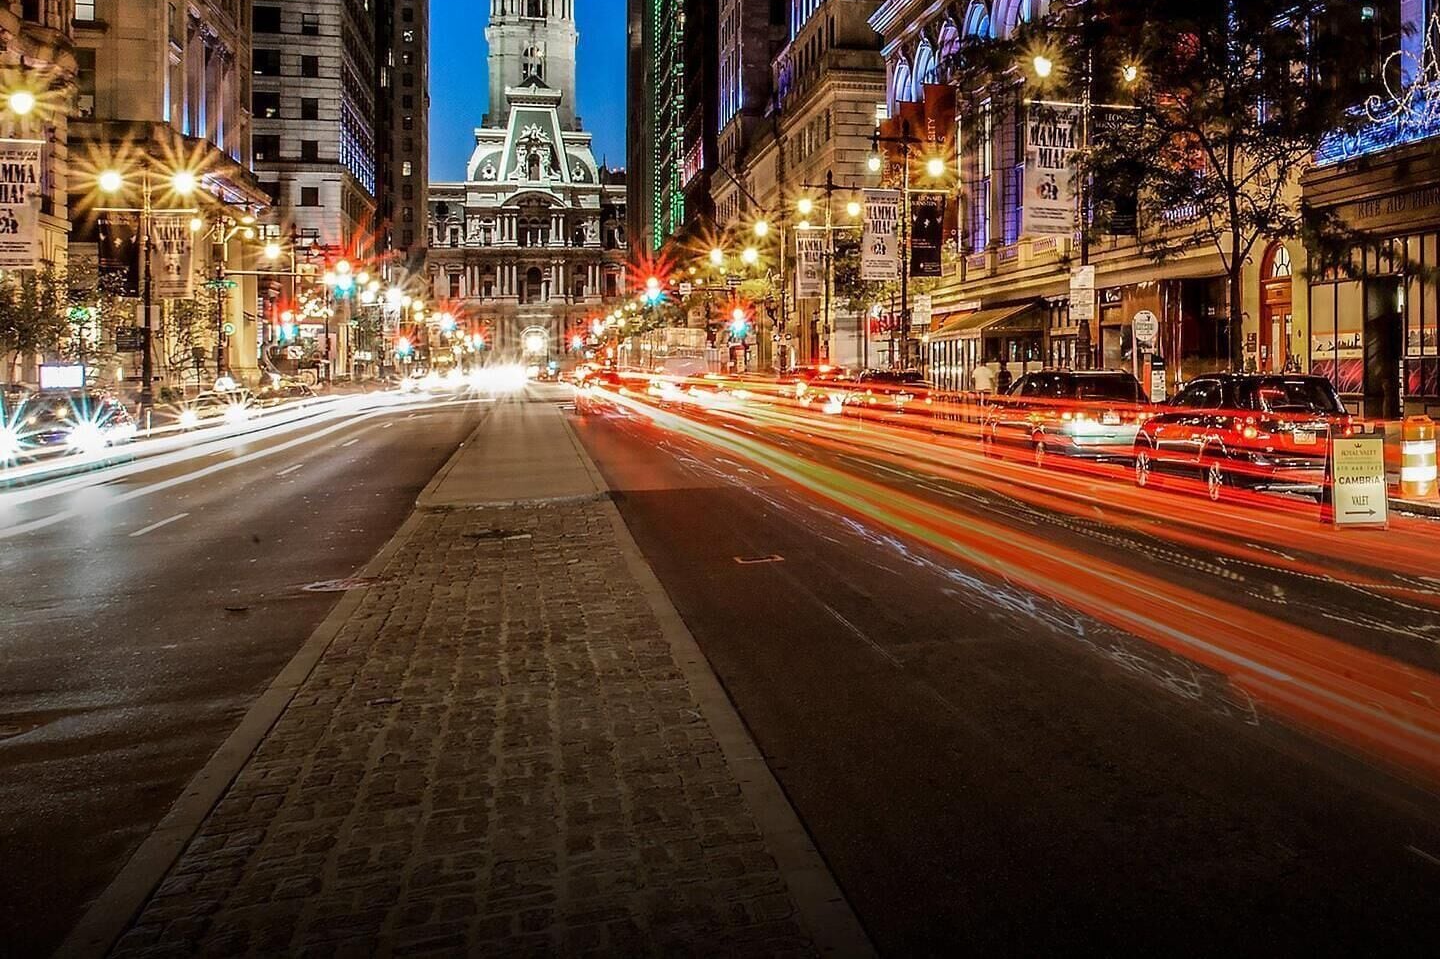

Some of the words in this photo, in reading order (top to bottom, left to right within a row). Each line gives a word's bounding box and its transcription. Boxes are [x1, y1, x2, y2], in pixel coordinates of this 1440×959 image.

[1029, 124, 1076, 149] MAMMA
[1037, 148, 1065, 169] MIA!
[1351, 495, 1369, 506] VALET
